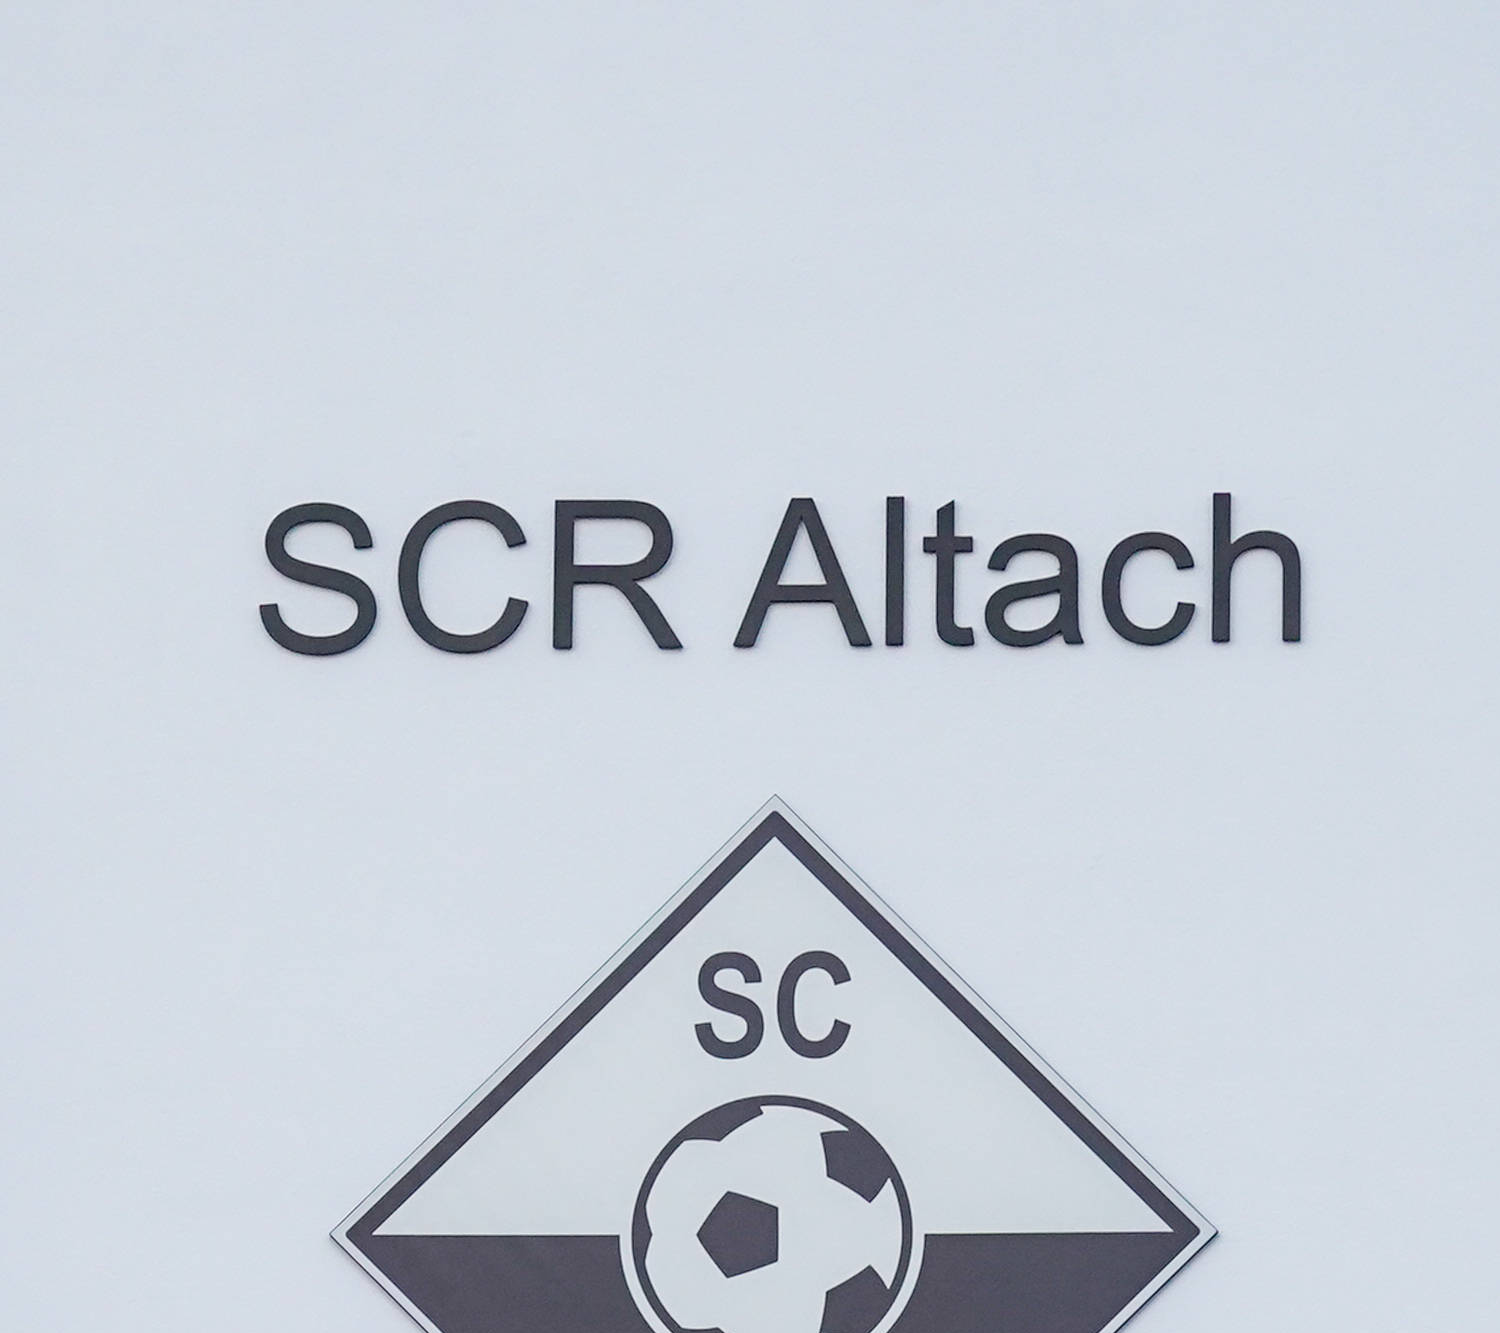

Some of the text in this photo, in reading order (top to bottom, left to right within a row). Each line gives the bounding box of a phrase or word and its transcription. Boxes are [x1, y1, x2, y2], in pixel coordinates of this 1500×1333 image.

[259, 493, 1303, 656] SCR Altach
[693, 950, 853, 1060] SC
